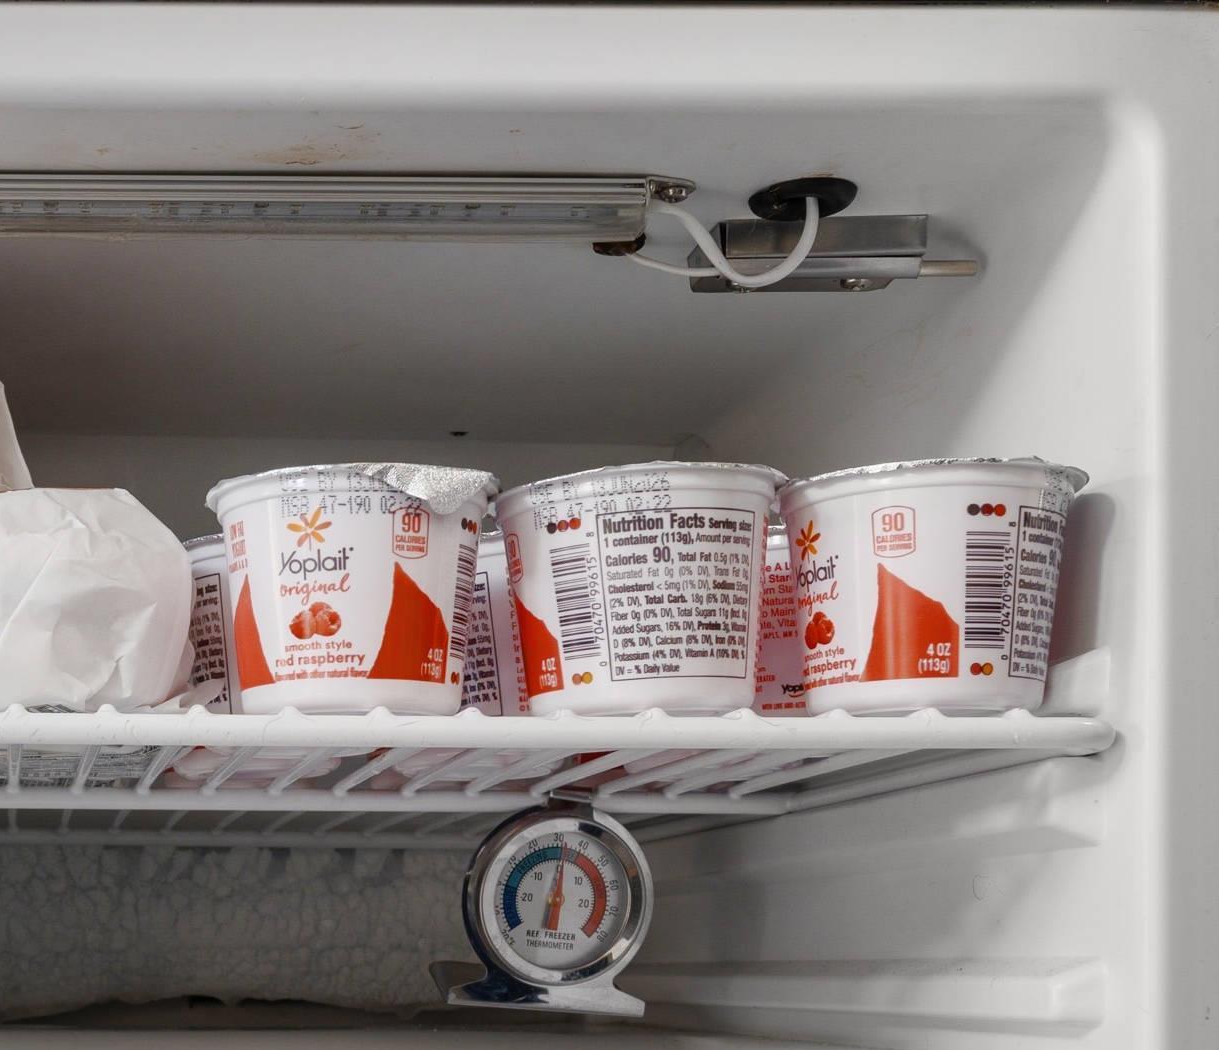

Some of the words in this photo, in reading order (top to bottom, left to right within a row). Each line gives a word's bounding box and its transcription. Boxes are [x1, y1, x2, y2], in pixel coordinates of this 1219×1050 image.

[401, 513, 422, 533] 90
[603, 517, 664, 534] Nutrition
[670, 513, 705, 530] Facts
[709, 517, 737, 532] Serving
[881, 512, 905, 532] 90
[1023, 511, 1058, 528] Nutrition
[395, 535, 426, 545] CALORIES
[612, 534, 658, 548] container
[660, 532, 694, 545] (113g),
[695, 533, 722, 543] Amount
[722, 535, 732, 545] per
[876, 532, 913, 544] CALORIES
[876, 543, 889, 552] PER
[890, 542, 913, 552] SERVING
[279, 547, 350, 580] Yoplait
[605, 553, 648, 567] Calories
[652, 546, 674, 564] 90,
[677, 552, 697, 562] Total
[699, 551, 712, 562] Fat
[713, 552, 728, 565] 0.5g
[1020, 549, 1047, 564] Calories
[606, 567, 643, 581] Saturated
[647, 567, 659, 577] Fat
[664, 567, 674, 579] 0g
[679, 566, 693, 577] (0%
[713, 566, 730, 577] Trans
[1003, 546, 1015, 587] 99615
[588, 555, 598, 596] 99615
[280, 573, 351, 605] original
[608, 581, 654, 595] Cholesterol
[664, 580, 681, 592] 5mg
[682, 579, 696, 591] (1%
[712, 580, 736, 591] Sodium
[610, 597, 624, 610] (2%
[645, 595, 664, 605] Total
[667, 595, 688, 604] Carb.
[691, 594, 704, 606] 18g
[611, 610, 628, 621] Fiber
[631, 610, 641, 621] 0g
[643, 608, 657, 620] (0%
[677, 607, 692, 617] Total
[695, 606, 716, 618] Sugars
[1000, 594, 1012, 635] 70470
[590, 602, 605, 643] 70470
[612, 623, 634, 635] Added
[697, 621, 721, 631] Protein
[285, 641, 321, 652] smooth
[325, 639, 352, 650] style
[655, 635, 683, 646] Calcium
[434, 648, 443, 661] OZ
[614, 651, 650, 662] Potassium
[685, 648, 709, 659] Vitamin
[824, 645, 845, 658] style
[926, 643, 936, 656] 4
[937, 643, 951, 656] OZ
[275, 653, 294, 667] red
[298, 653, 365, 667] raspberry
[548, 657, 556, 671] OZ
[810, 658, 856, 675] raspberry
[917, 658, 950, 673] (113g)
[420, 662, 442, 679] (113g)
[615, 665, 625, 677] DV
[643, 663, 660, 675] Daily
[662, 663, 680, 674] Value
[553, 833, 564, 842] 30
[577, 840, 589, 850] 40
[574, 876, 583, 885] 10
[578, 899, 589, 908] 20
[544, 930, 576, 941] FREEZER
[526, 939, 574, 950] THERMOMETER
